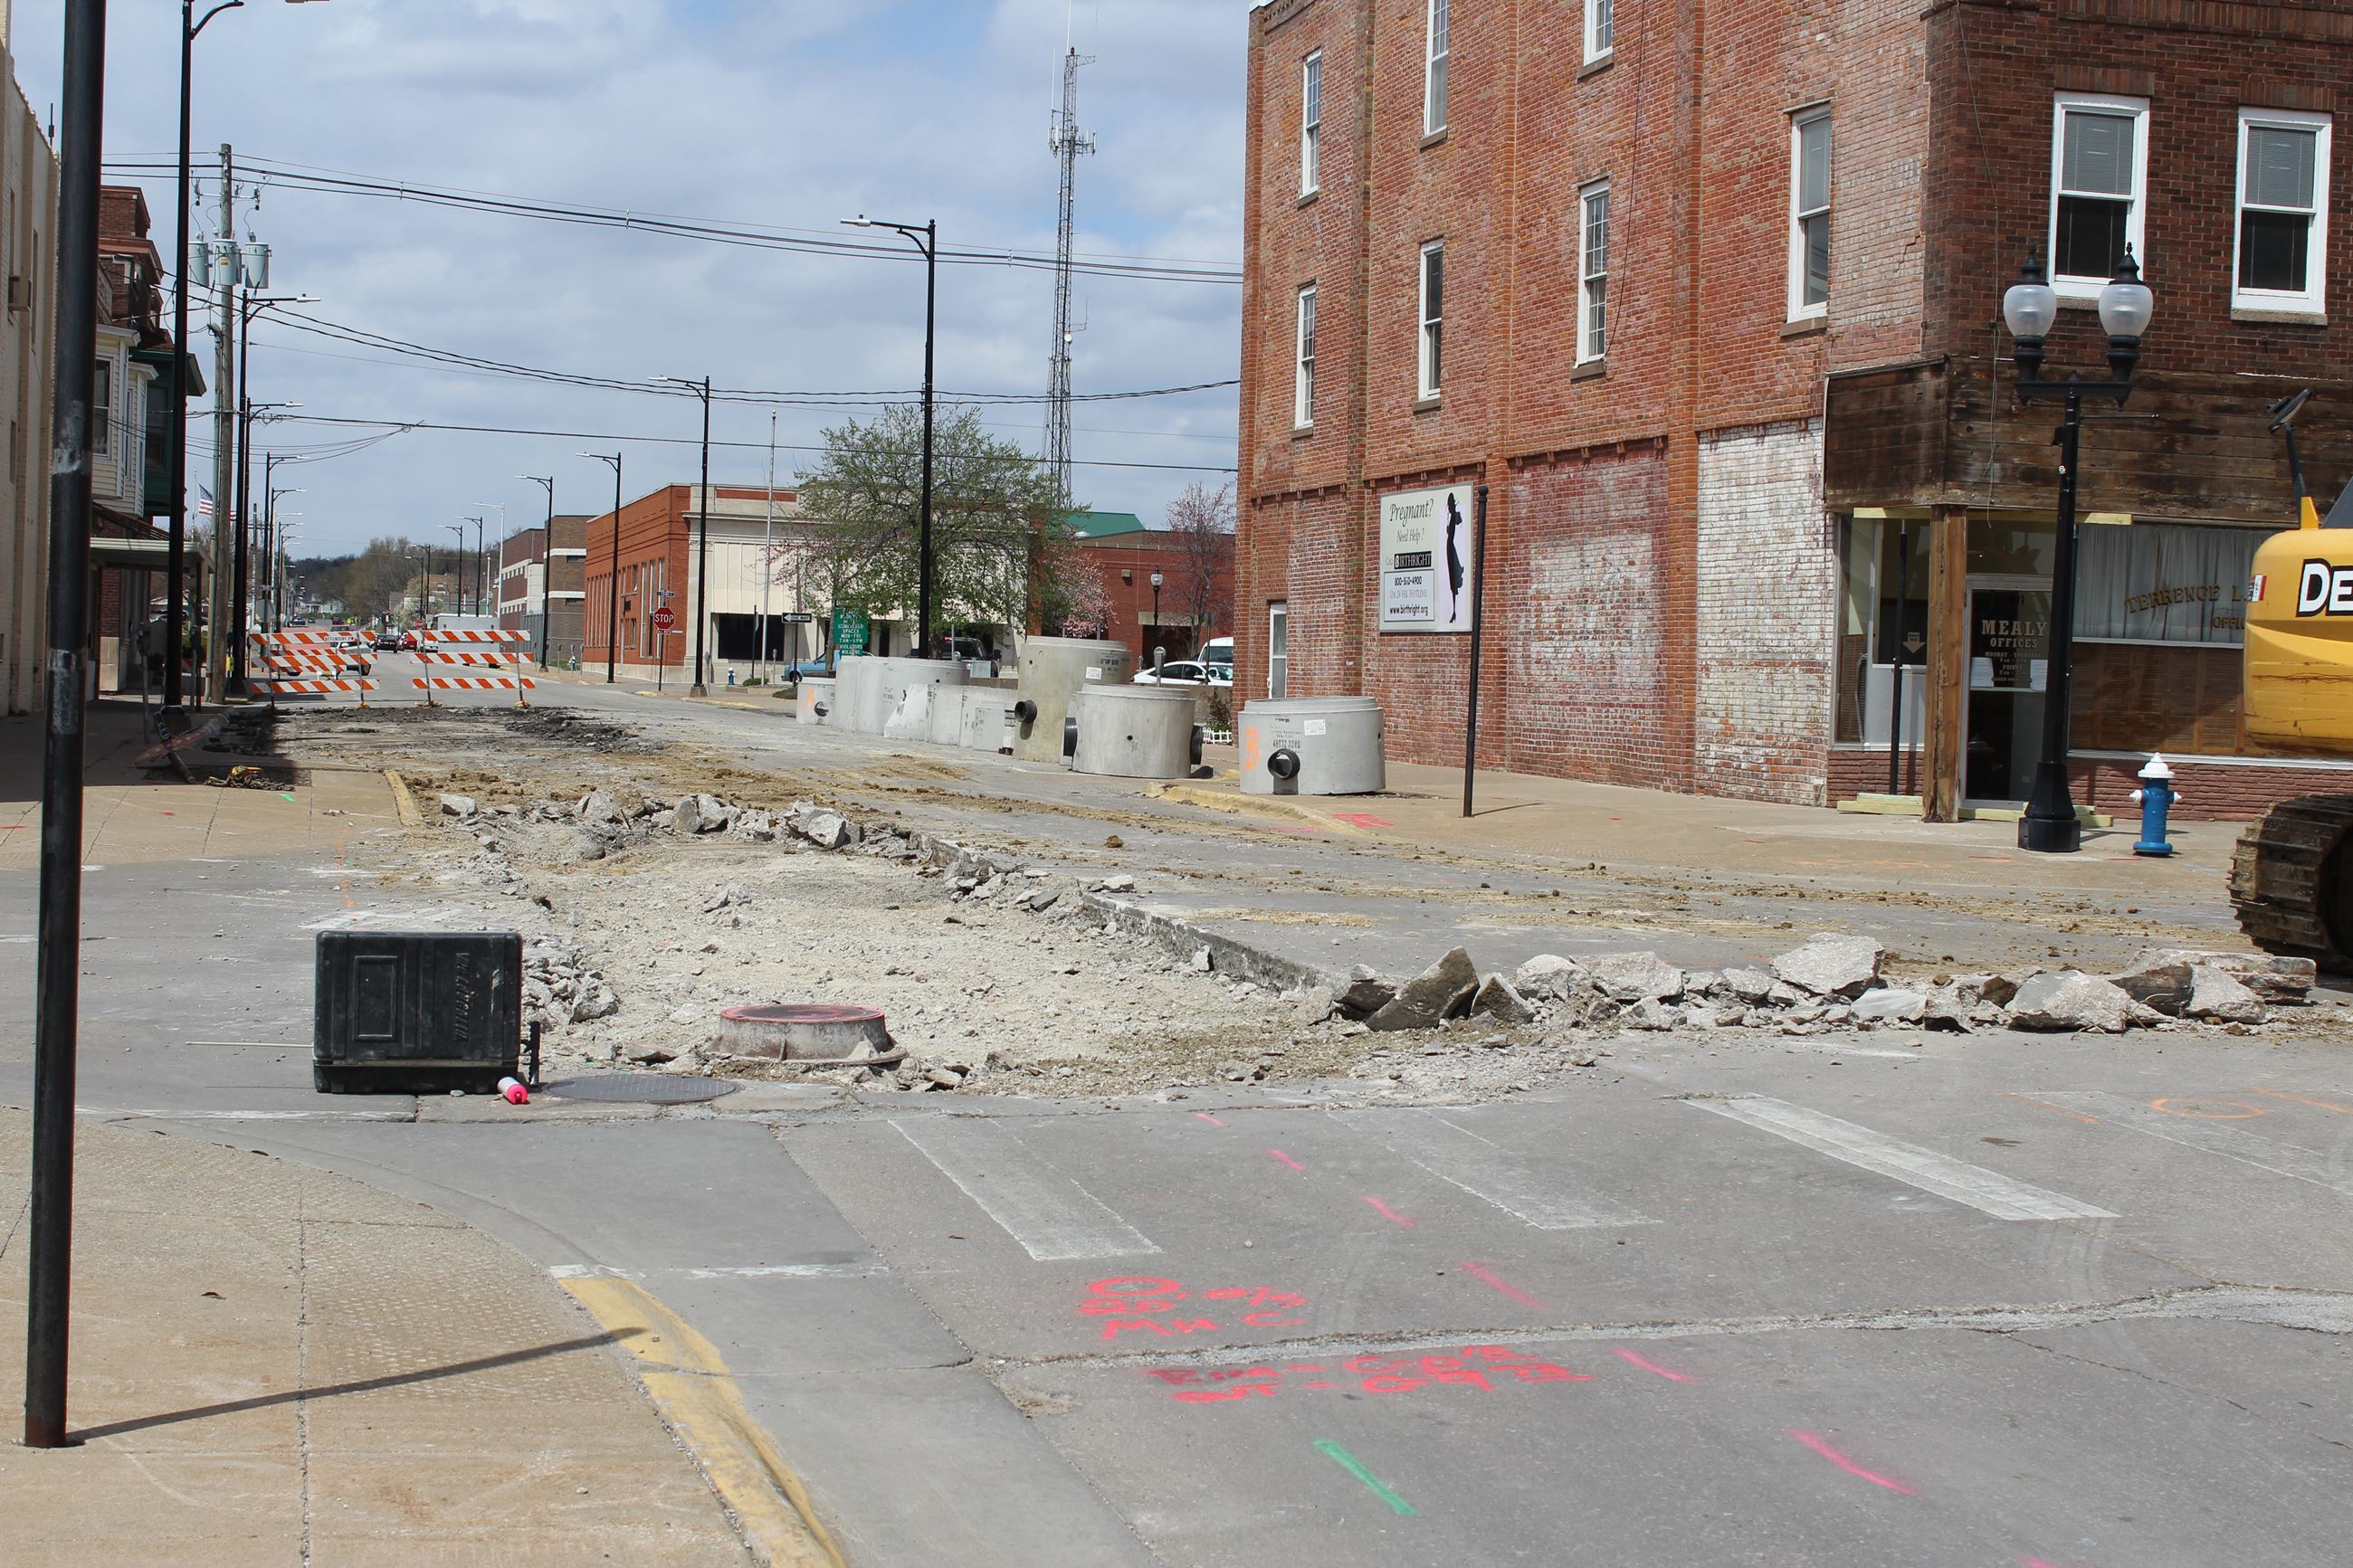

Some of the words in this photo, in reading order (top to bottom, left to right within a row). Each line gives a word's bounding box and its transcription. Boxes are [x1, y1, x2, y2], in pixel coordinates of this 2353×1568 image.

[1389, 498, 1434, 527] Pregnant?
[1397, 528, 1409, 543] Need
[1410, 527, 1421, 545] Help
[1395, 554, 1431, 568] BIRTHRIGHT
[1409, 588, 1427, 598] HOTLINE
[2124, 585, 2221, 614] TERRENCE
[1389, 603, 1428, 616] www.birthright.org
[654, 614, 673, 623] STOP
[1981, 620, 2047, 637] MEALY
[1990, 638, 2038, 649] OFFICES
